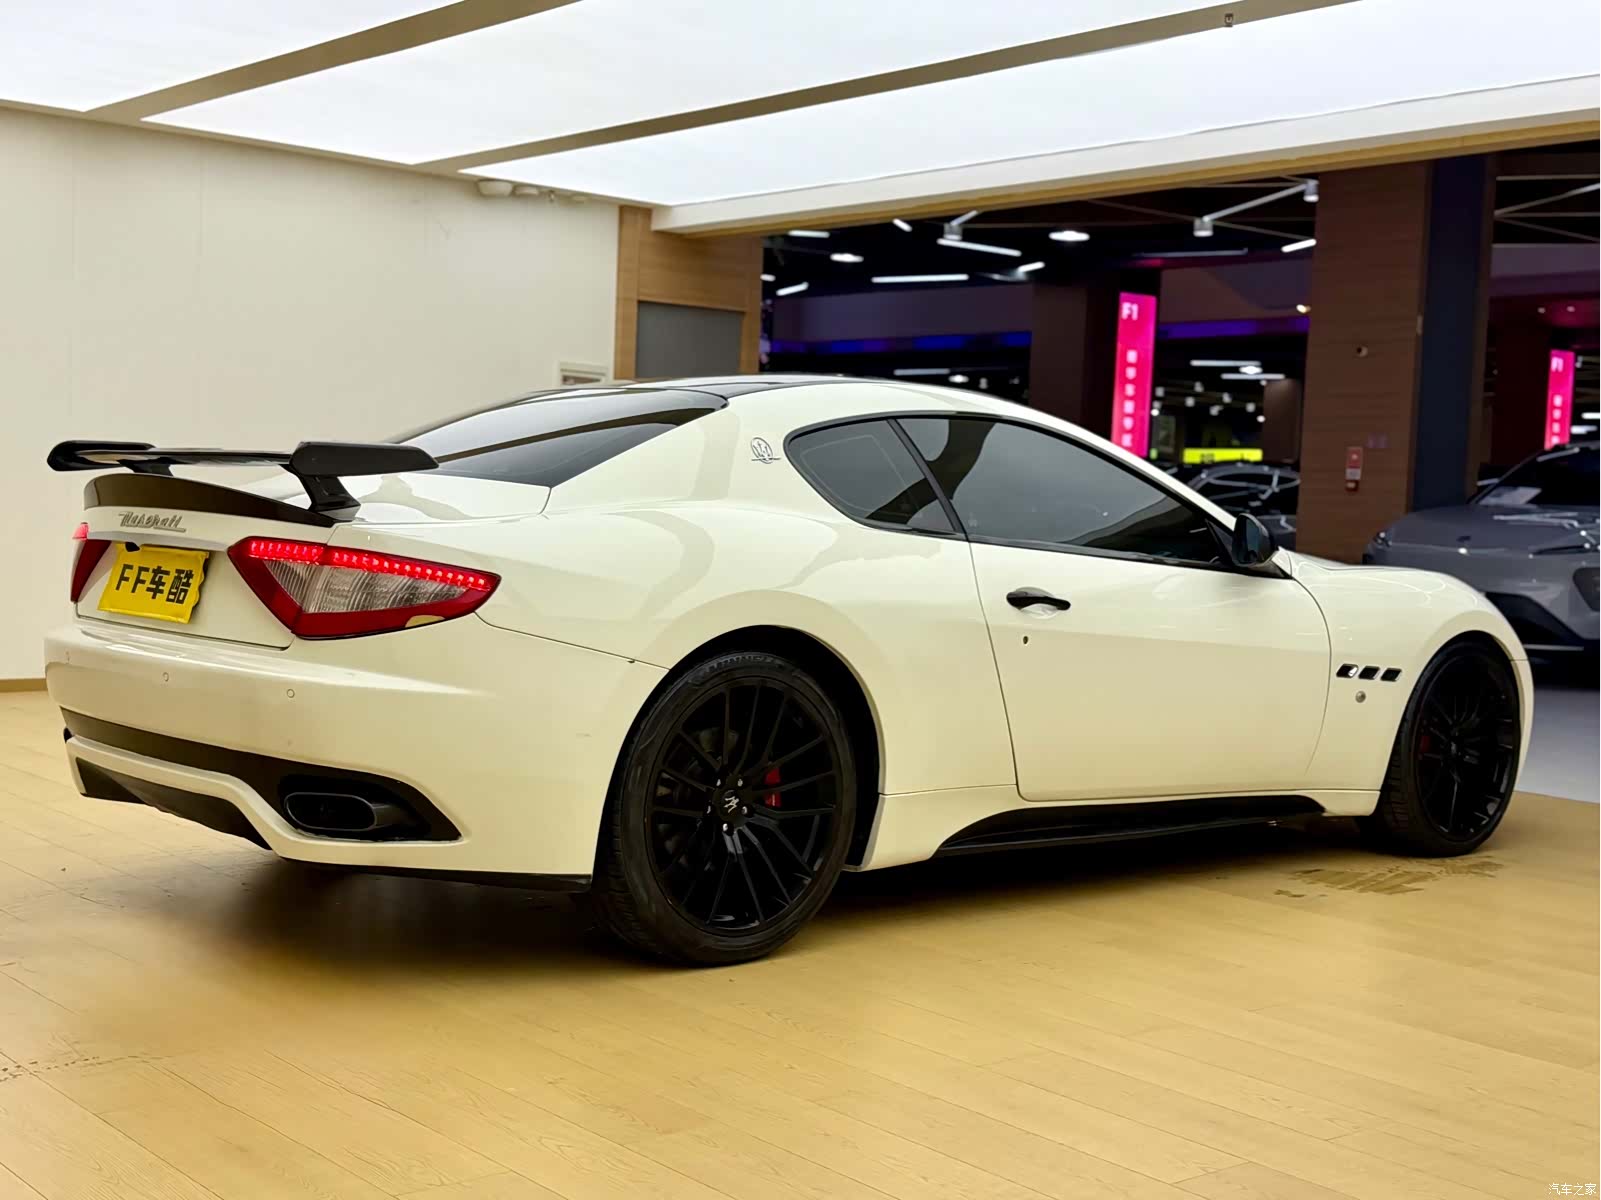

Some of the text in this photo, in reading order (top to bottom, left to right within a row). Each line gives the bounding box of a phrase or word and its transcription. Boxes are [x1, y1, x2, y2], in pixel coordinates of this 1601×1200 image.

[1121, 302, 1139, 321] F1
[118, 511, 187, 533] Maserati
[115, 563, 194, 605] FF车酷
